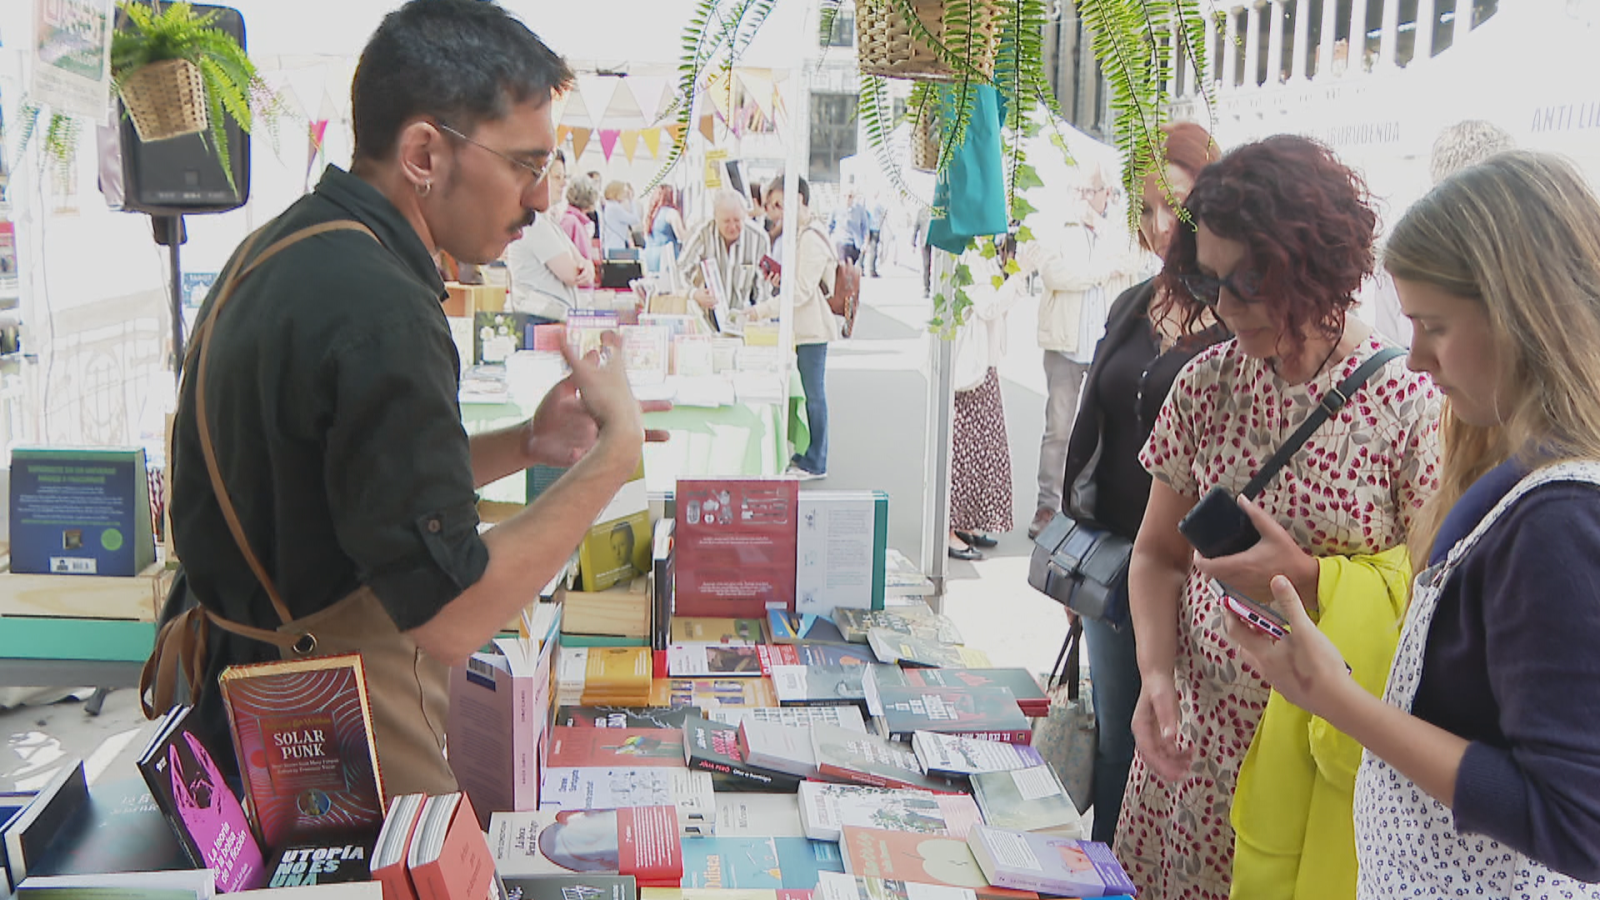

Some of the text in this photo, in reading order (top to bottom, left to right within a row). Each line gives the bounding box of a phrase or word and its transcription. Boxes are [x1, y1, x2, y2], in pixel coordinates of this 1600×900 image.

[1531, 104, 1573, 133] ANTI
[1326, 121, 1400, 146] IBURUDENDA
[273, 729, 325, 746] SOLAR
[281, 743, 325, 760] PUNK
[208, 821, 230, 863] La teoría
[220, 831, 236, 858] bolsa
[515, 826, 526, 849] La boca
[217, 855, 225, 868] la
[221, 830, 247, 885] de la ficción
[281, 845, 364, 863] UTOPÍA
[275, 860, 340, 875] NO ES
[703, 854, 721, 888] Odisea
[269, 873, 317, 888] UNA
